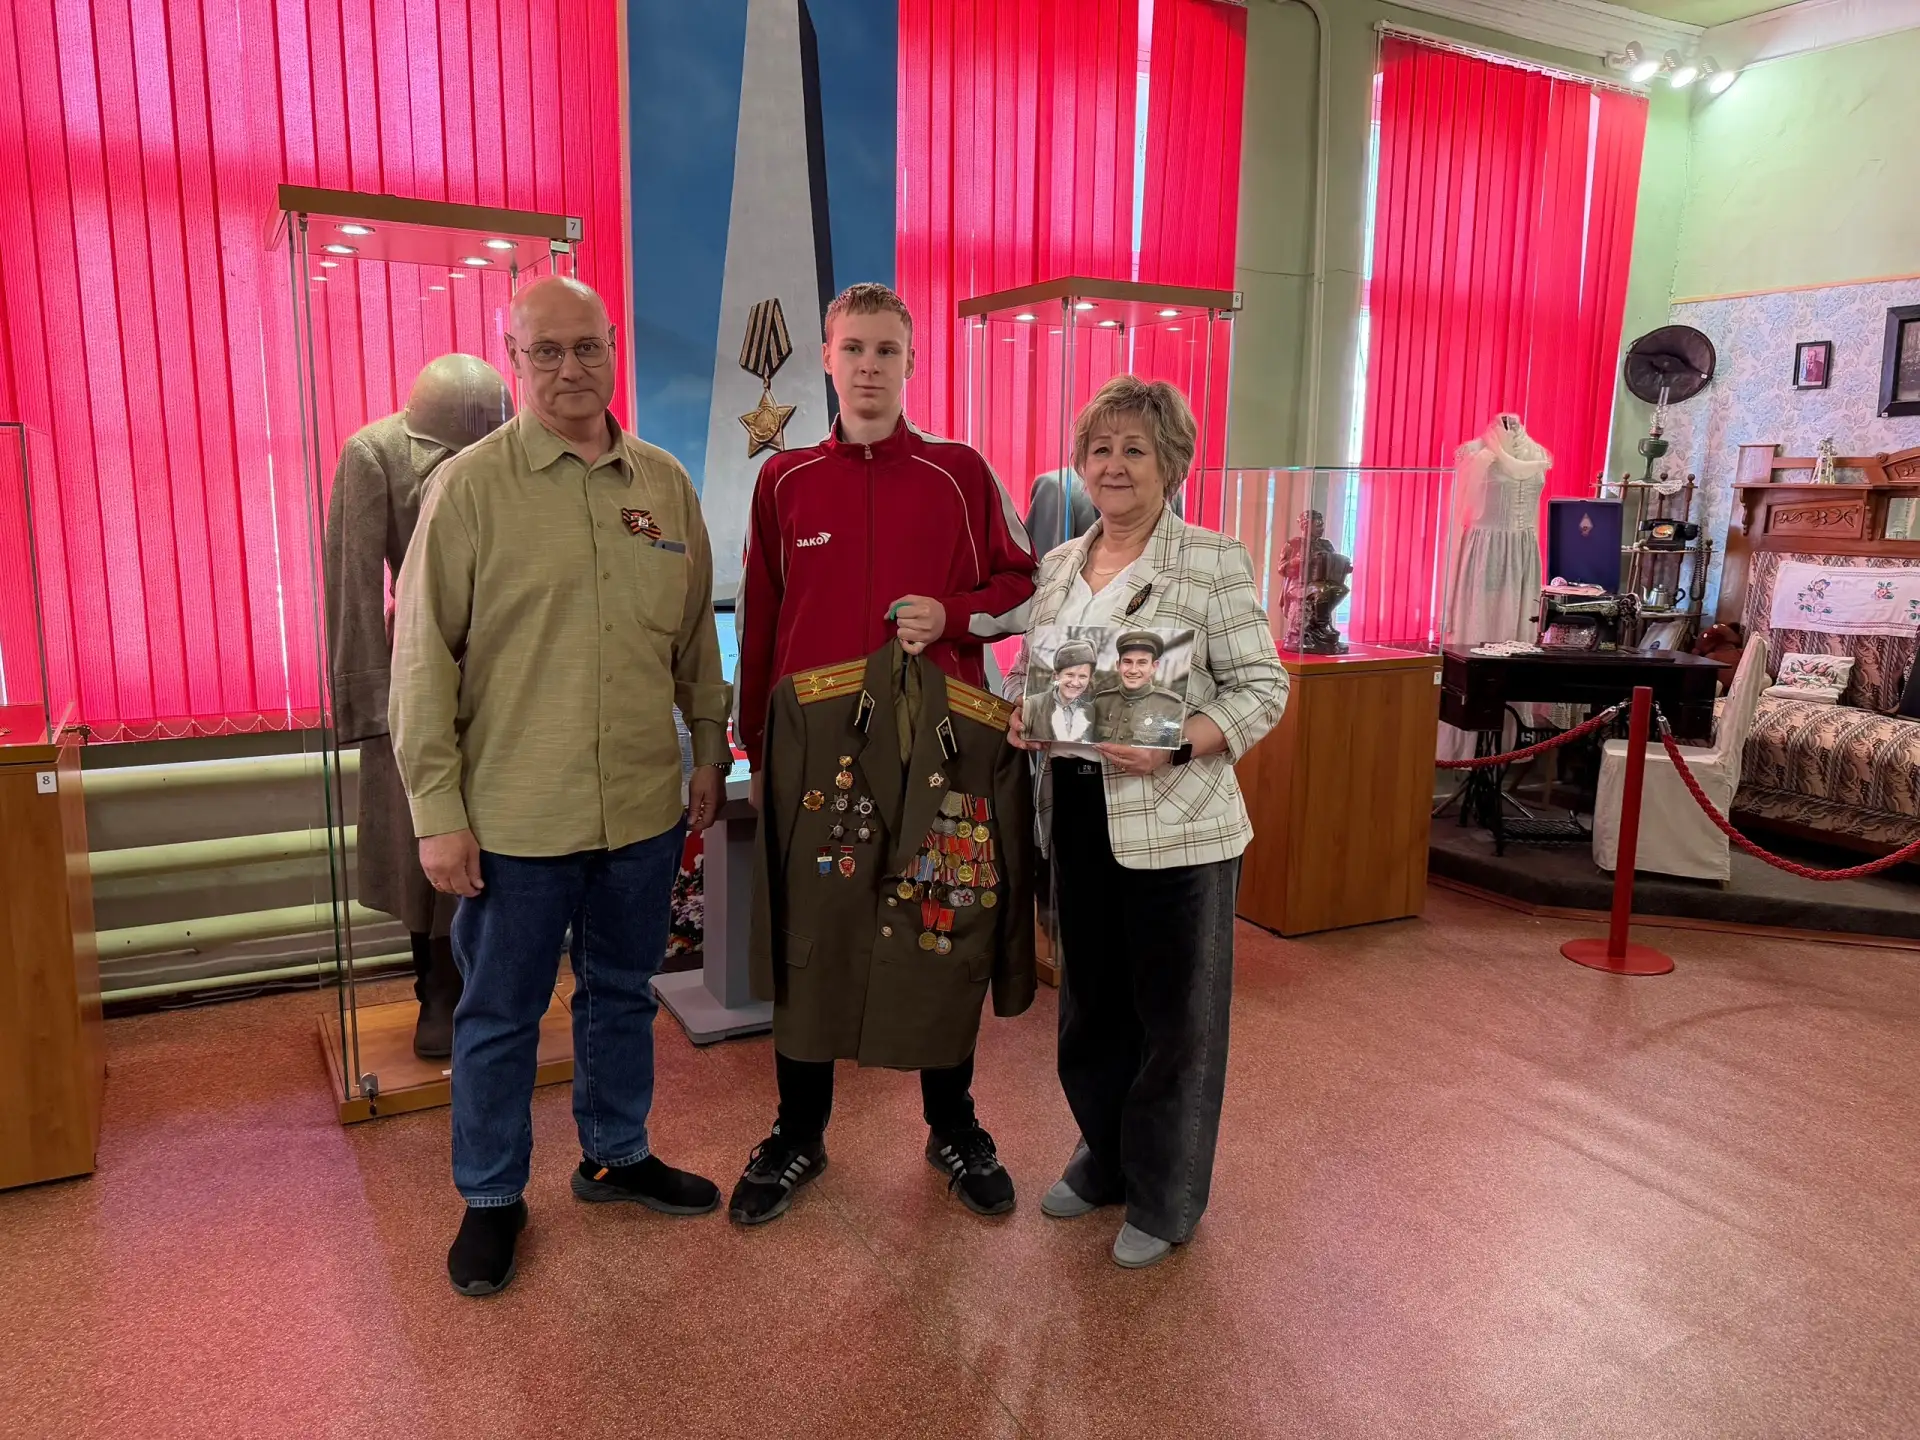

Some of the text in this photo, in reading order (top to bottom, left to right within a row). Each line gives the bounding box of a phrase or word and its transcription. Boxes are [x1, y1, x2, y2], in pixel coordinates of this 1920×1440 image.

[570, 221, 577, 231] 7
[796, 536, 824, 548] JAKO
[42, 775, 51, 785] 8
